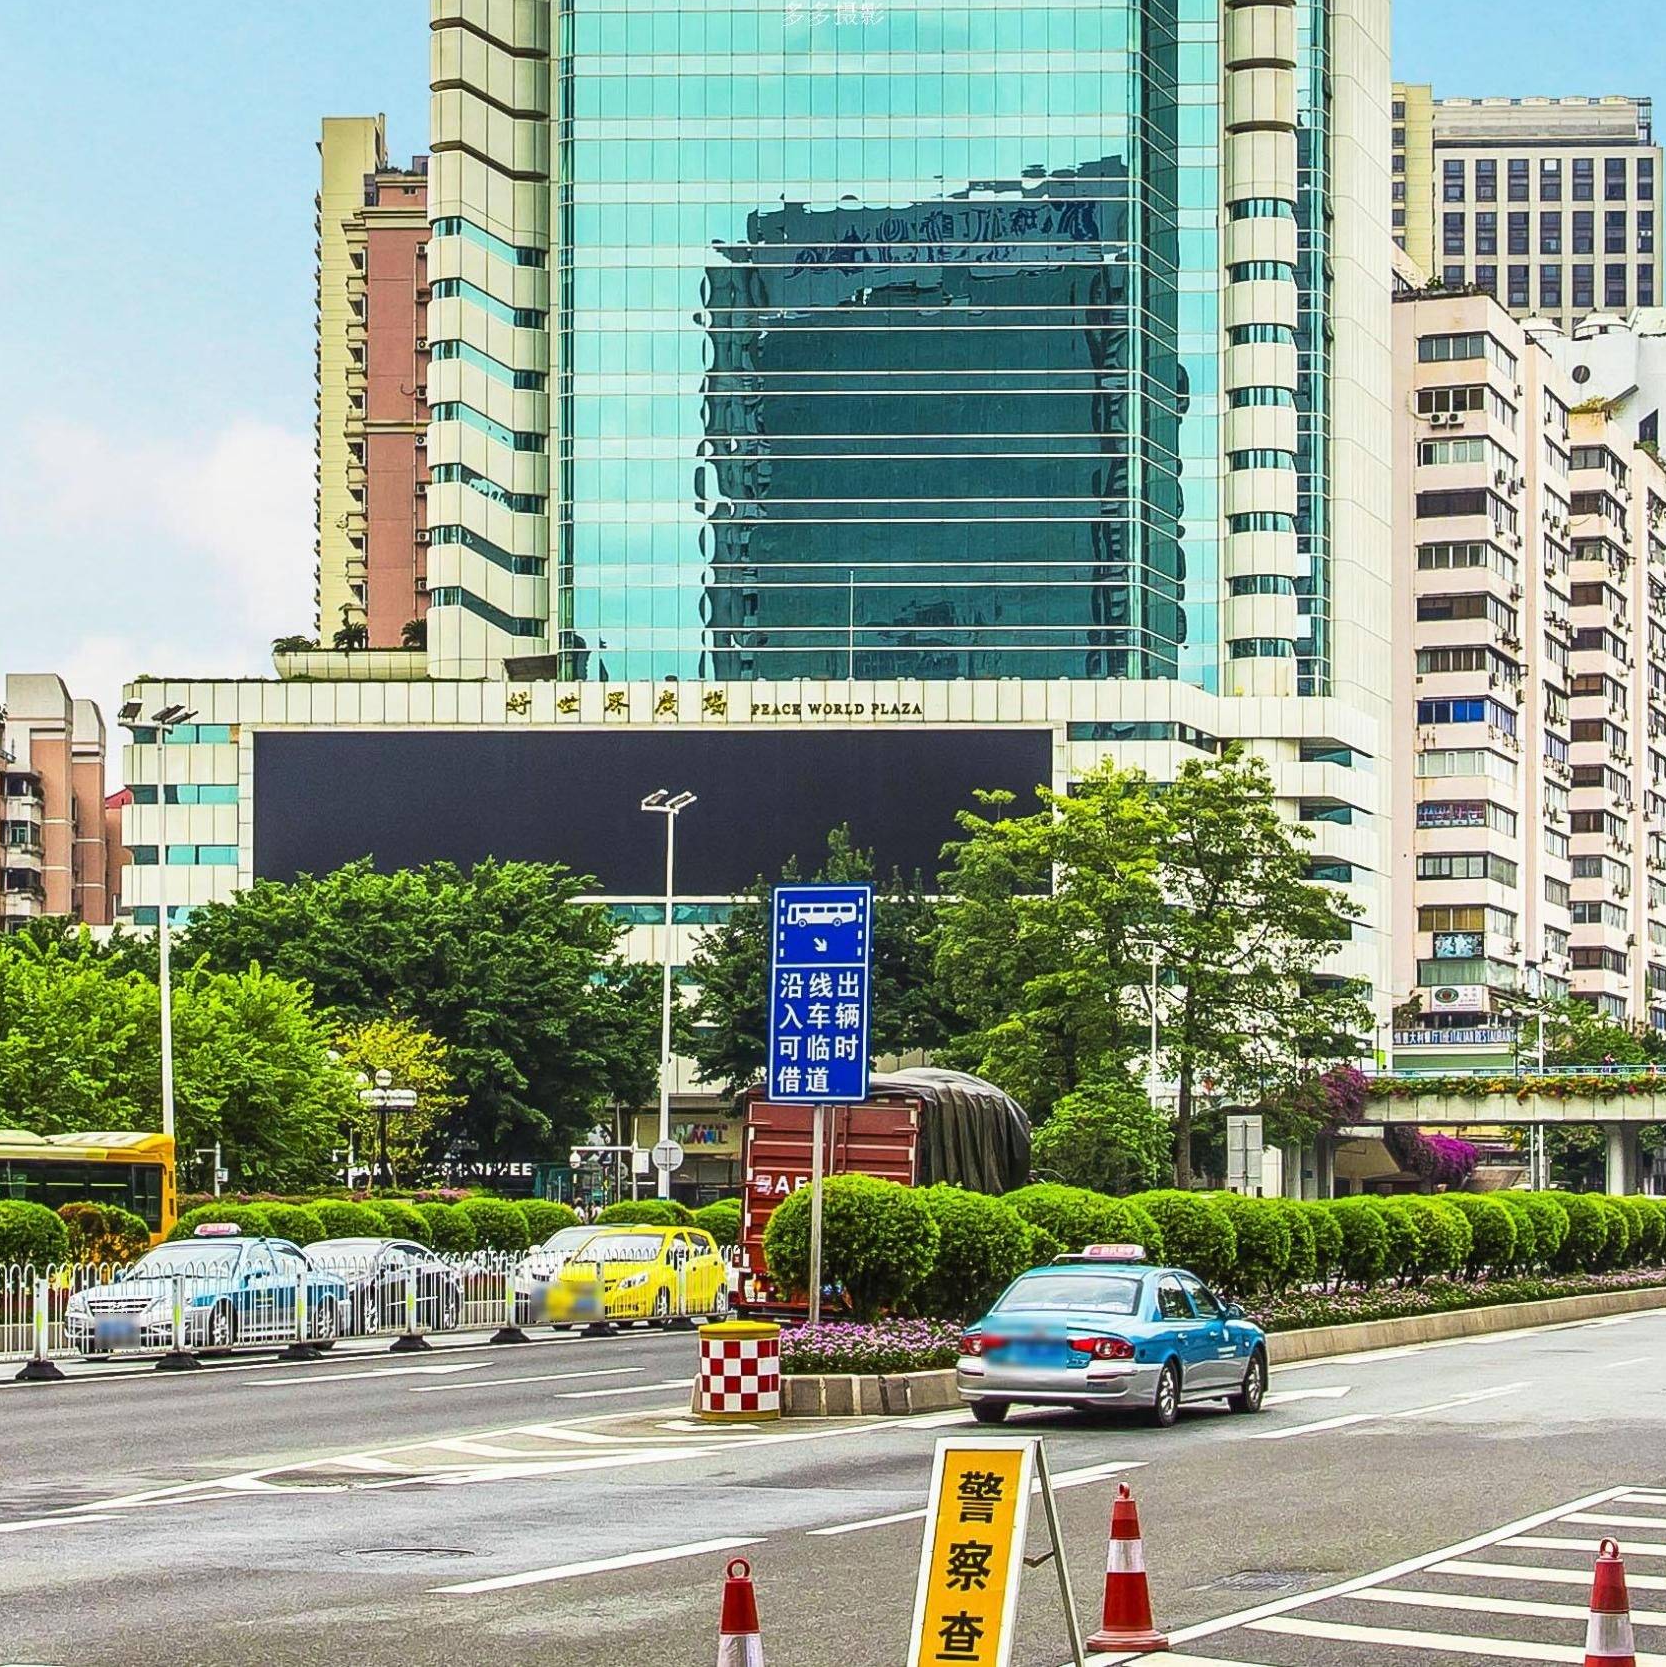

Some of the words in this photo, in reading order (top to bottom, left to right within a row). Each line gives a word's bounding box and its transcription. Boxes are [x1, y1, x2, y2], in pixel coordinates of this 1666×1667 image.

[752, 703, 801, 715] PEACE
[808, 703, 865, 715] WORLD
[871, 703, 922, 715] PLAZA
[780, 971, 859, 999] 沿线出
[779, 1002, 860, 1029] 入车辆
[778, 1034, 859, 1061] 可临时
[777, 1065, 830, 1094] 借道
[935, 1470, 1004, 1662] 警察查
